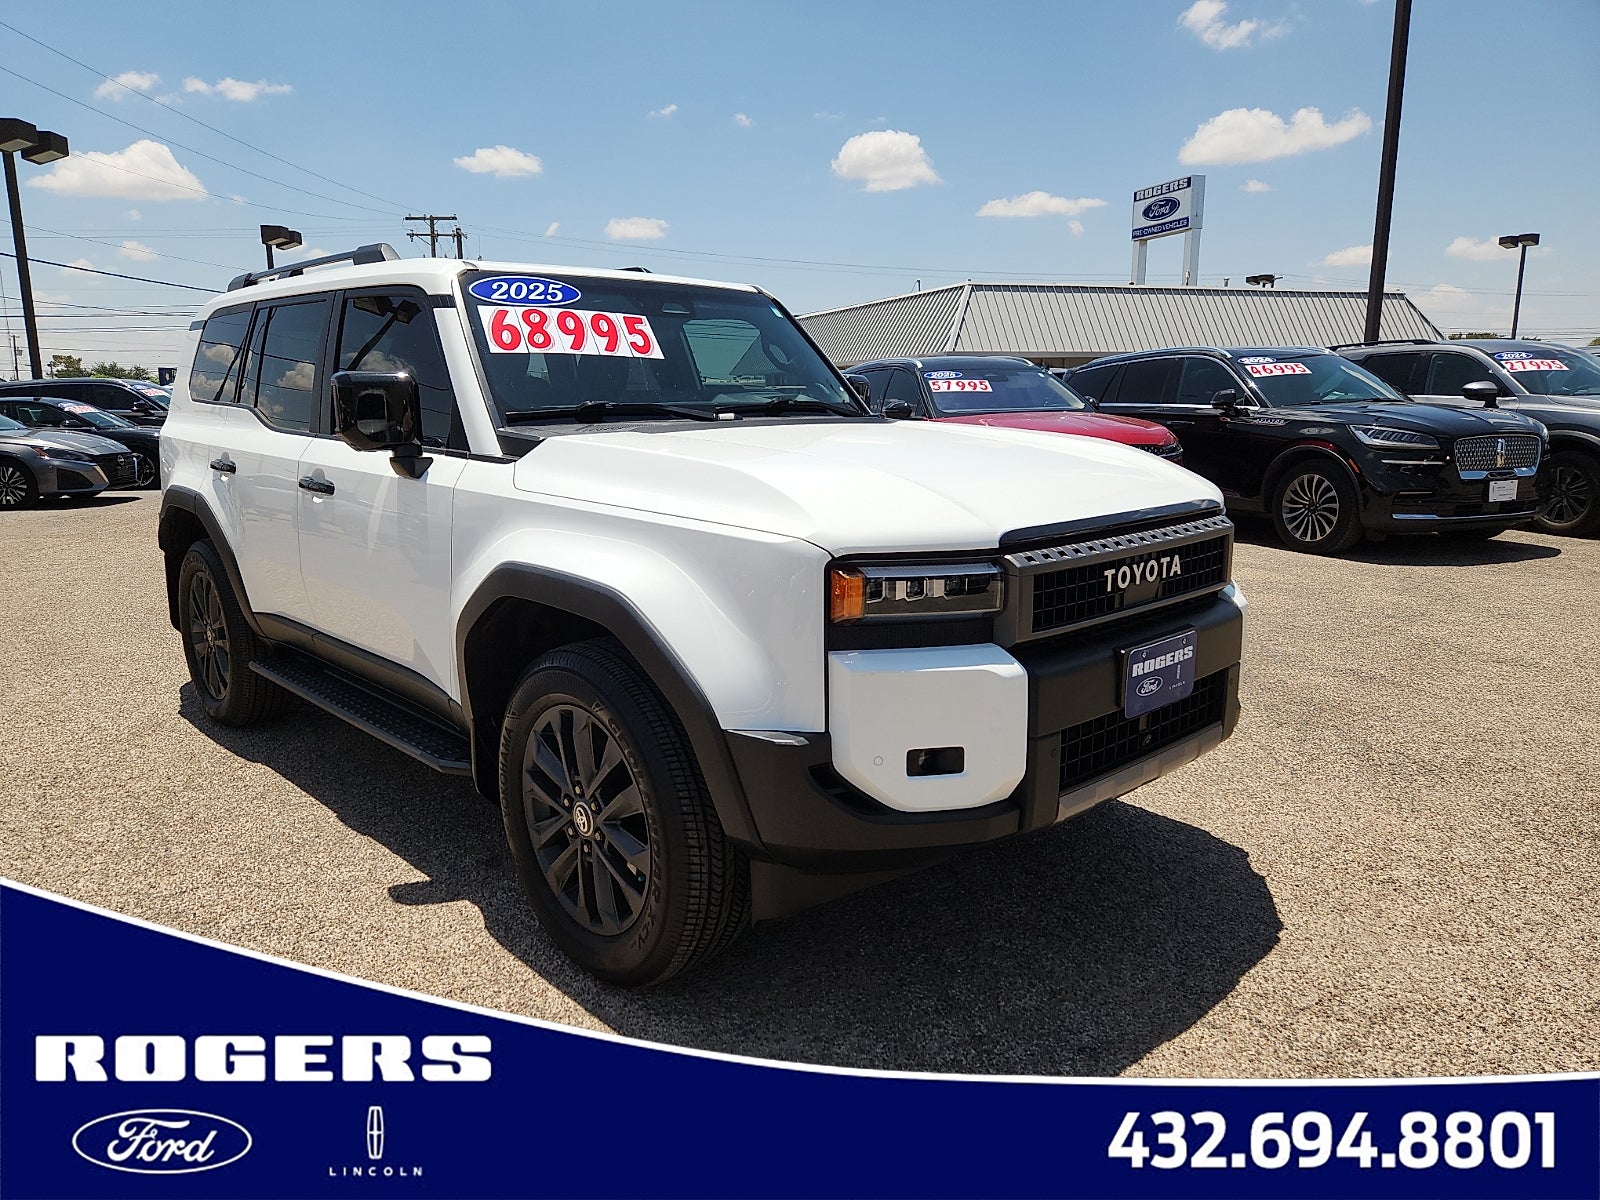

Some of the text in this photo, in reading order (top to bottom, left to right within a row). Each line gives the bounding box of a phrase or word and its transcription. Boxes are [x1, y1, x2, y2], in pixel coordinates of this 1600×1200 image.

[1135, 178, 1188, 201] ROGERS
[1148, 200, 1172, 218] Ford
[1132, 219, 1188, 238] PRE-OWNED VEHICLES
[490, 281, 564, 302] 2025
[489, 307, 655, 356] 68995
[1250, 363, 1307, 375] 46995
[931, 380, 988, 391] 57995
[1103, 554, 1182, 592] TOYOTA
[1131, 645, 1194, 678] ROGERS
[1140, 679, 1159, 694] Ford
[499, 726, 513, 818] YOKOHAMA
